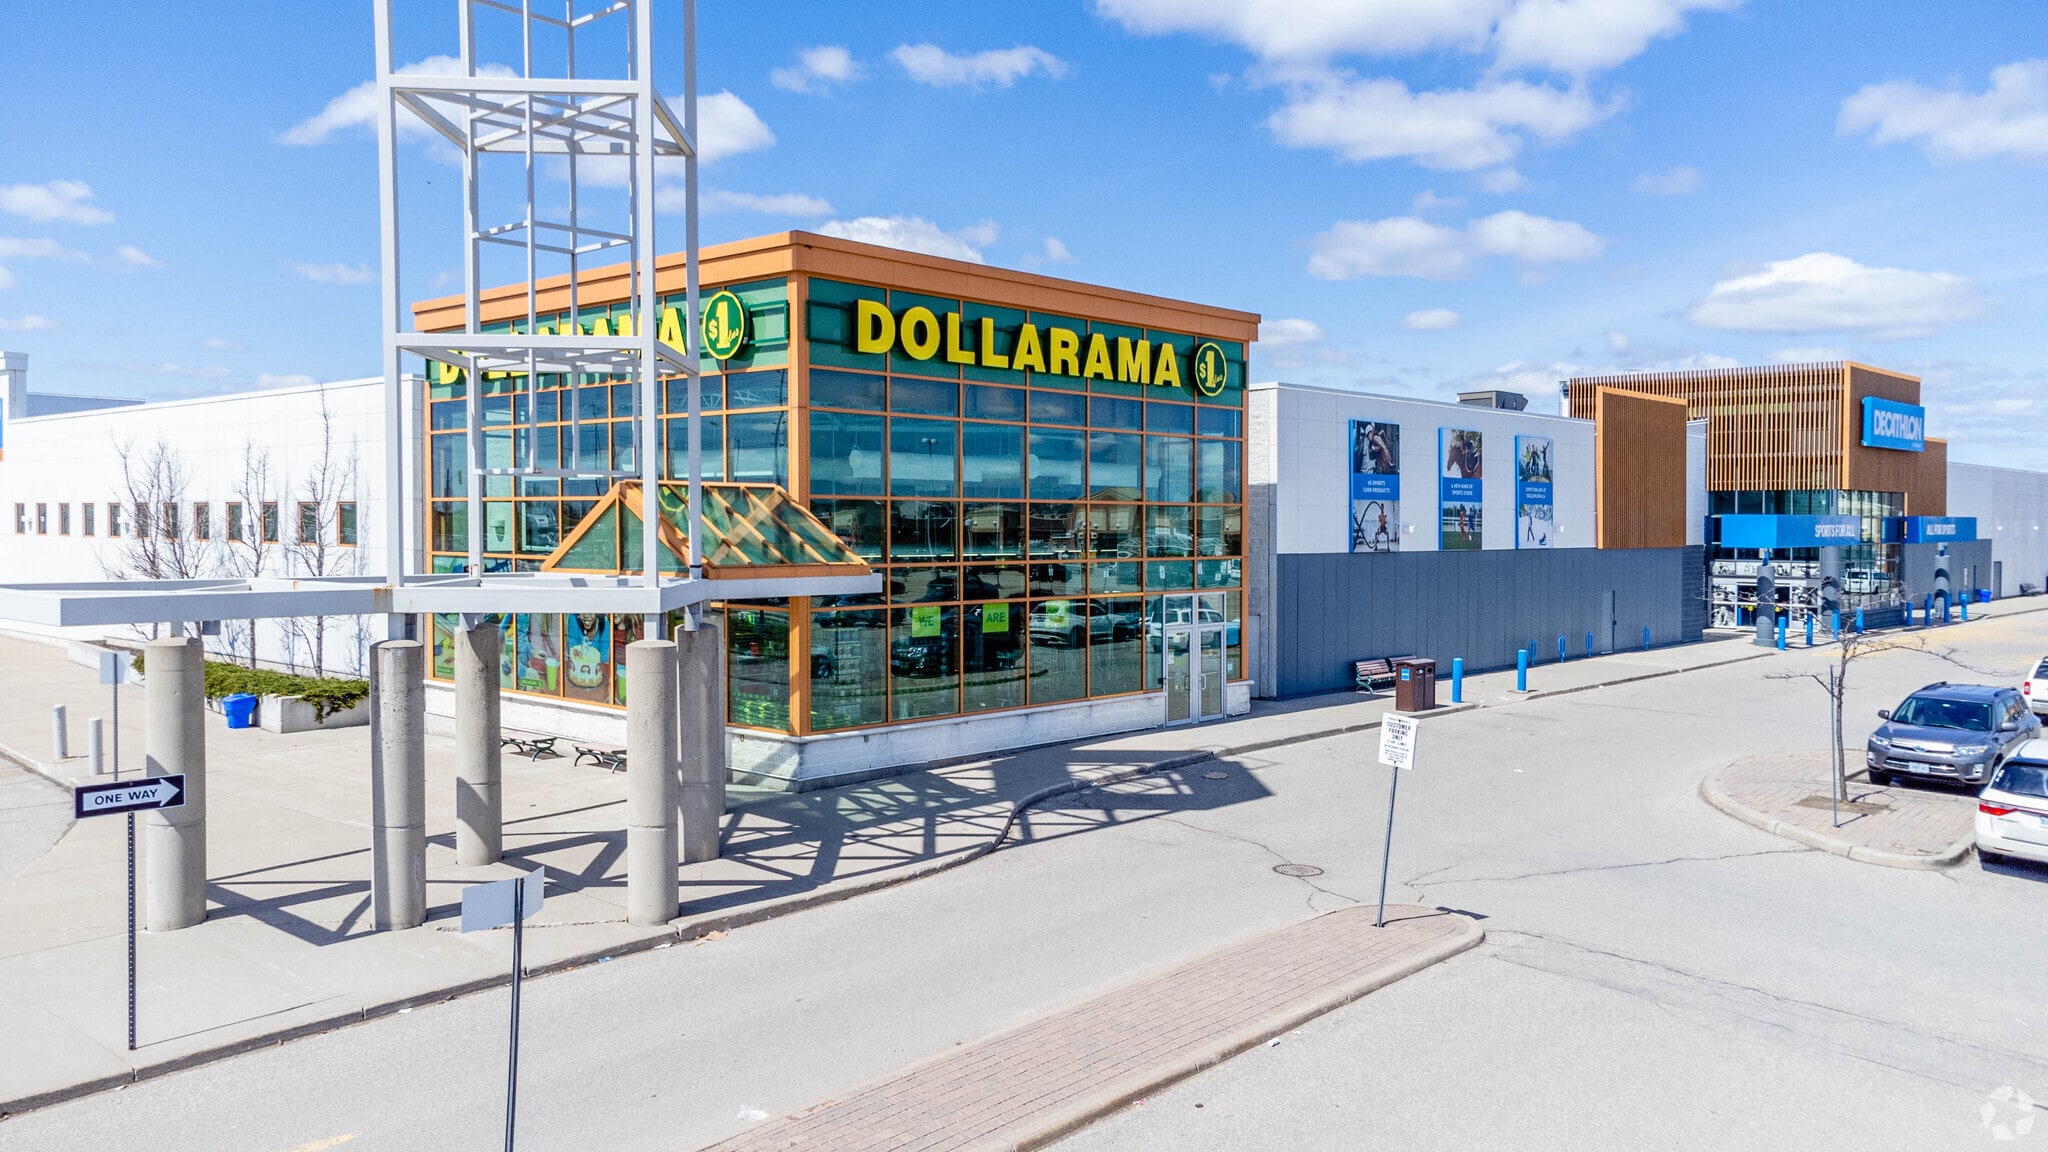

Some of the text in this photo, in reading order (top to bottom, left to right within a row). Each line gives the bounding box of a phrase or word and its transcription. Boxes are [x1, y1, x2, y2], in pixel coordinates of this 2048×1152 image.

[857, 299, 1181, 388] DOLLARAMA
[1873, 409, 1922, 441] DECATHLON
[1815, 524, 1855, 537] SPORTS FOR ALL
[1926, 525, 1935, 535] ALL
[1941, 524, 1956, 535] SPORTS
[986, 613, 1006, 623] ARE
[1387, 721, 1411, 731] CUSTOMER
[1389, 728, 1409, 736] PARKING
[94, 789, 158, 805] ONE WAY
